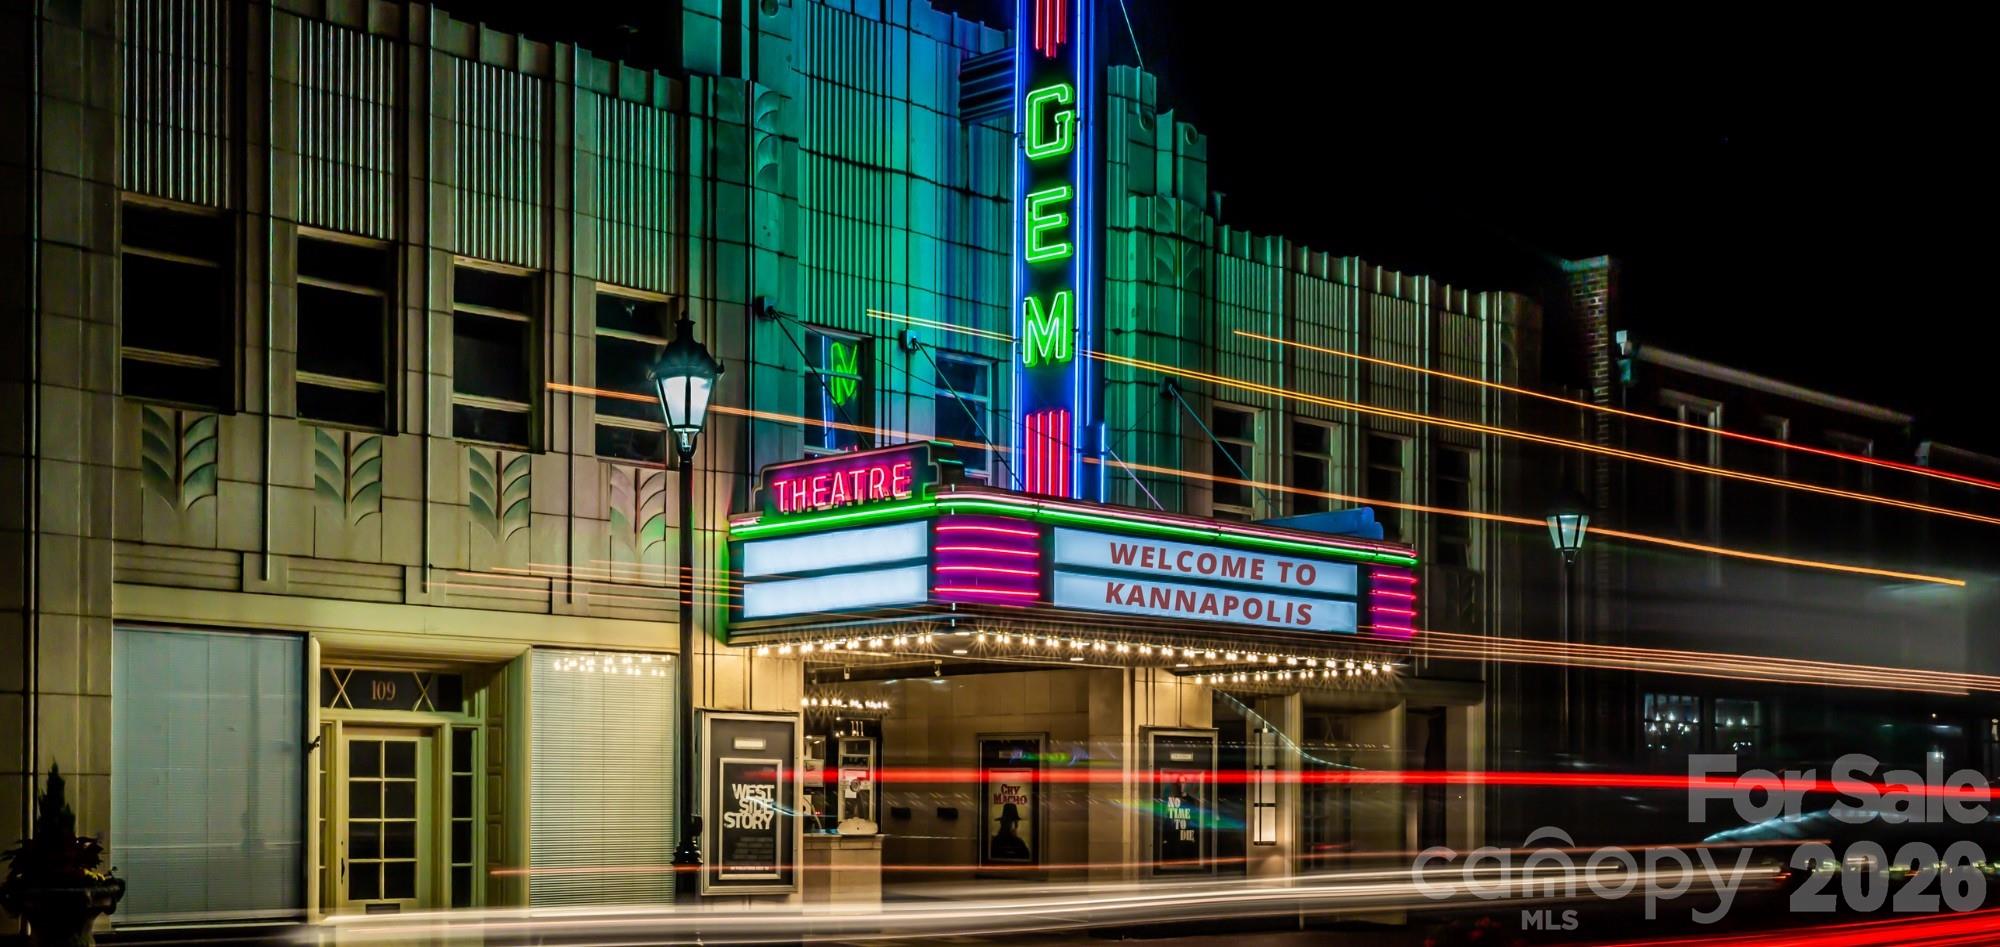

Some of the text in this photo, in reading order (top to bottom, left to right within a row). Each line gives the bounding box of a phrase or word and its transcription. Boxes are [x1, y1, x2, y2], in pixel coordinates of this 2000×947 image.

[1023, 82, 1074, 368] GEM
[773, 462, 912, 514] THEATRE
[1110, 542, 1317, 586] WELCOME TO
[1105, 581, 1313, 626] KANNAPOLIS
[372, 679, 396, 701] 109
[731, 783, 775, 801] WEST
[738, 799, 775, 815] SIDE
[1167, 796, 1181, 808] NO
[723, 811, 775, 830] STORY
[1168, 808, 1191, 820] TIME
[1174, 819, 1187, 830] TO
[1180, 829, 1195, 841] DIE
